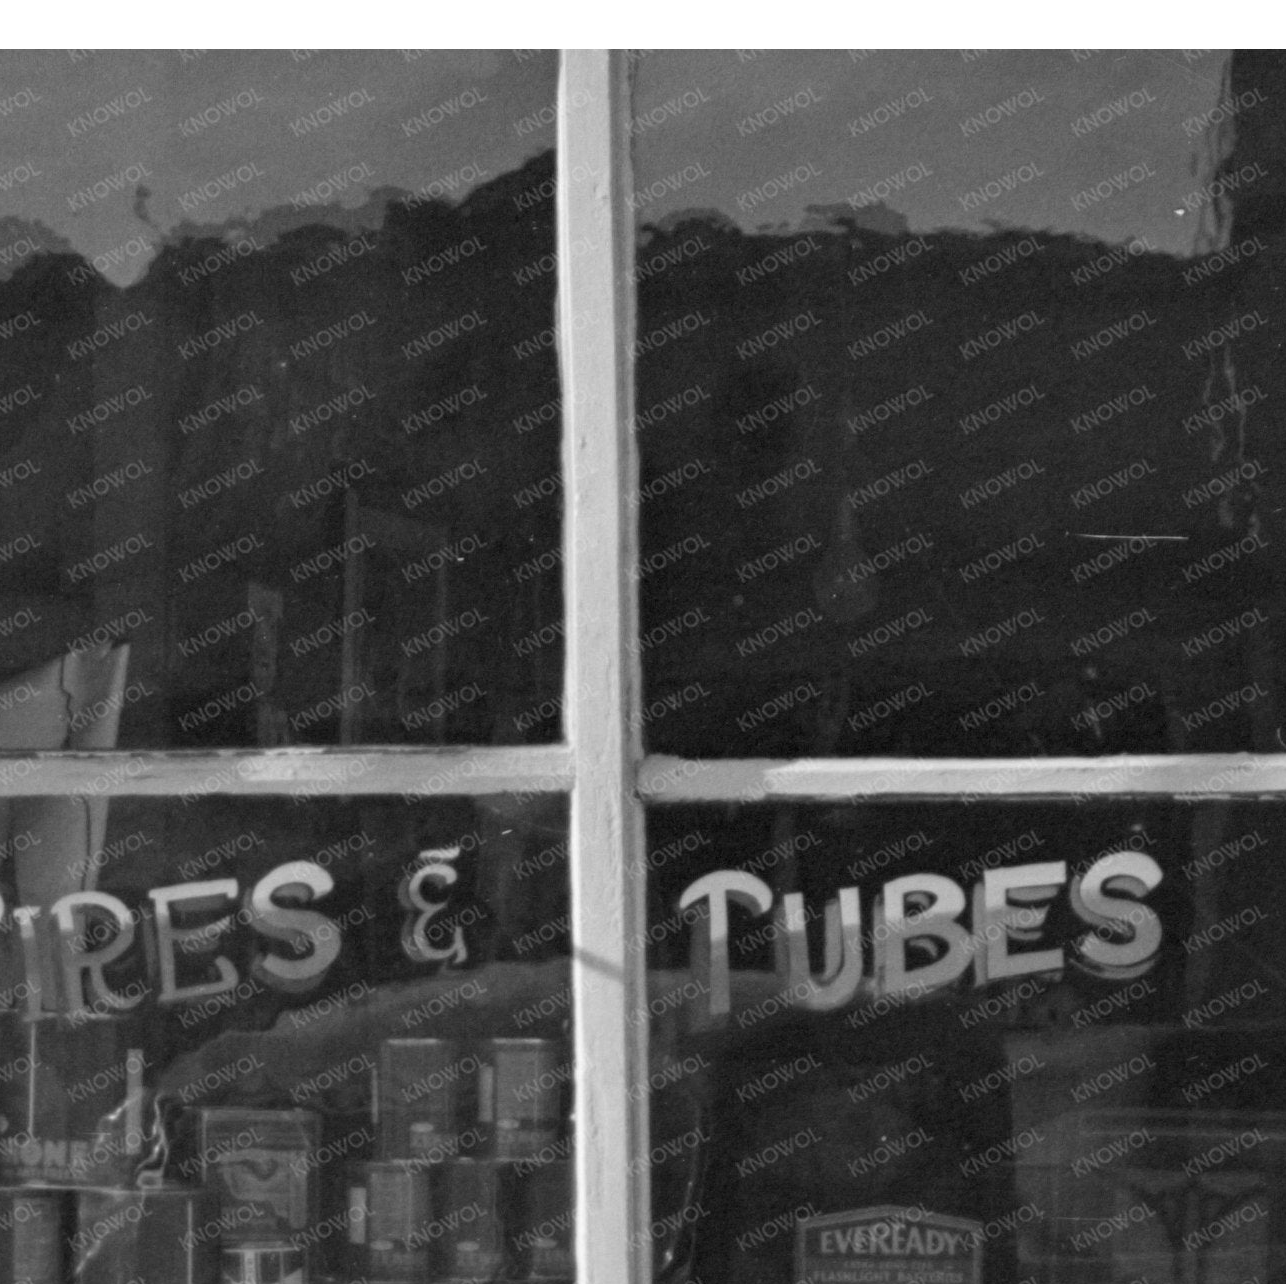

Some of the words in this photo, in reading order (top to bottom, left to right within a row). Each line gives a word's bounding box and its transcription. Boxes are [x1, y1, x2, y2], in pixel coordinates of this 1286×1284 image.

[680, 850, 1164, 1018] TUBES
[820, 1222, 961, 1256] EVEREADY
[813, 1271, 890, 1282] FLASHLIGHT
